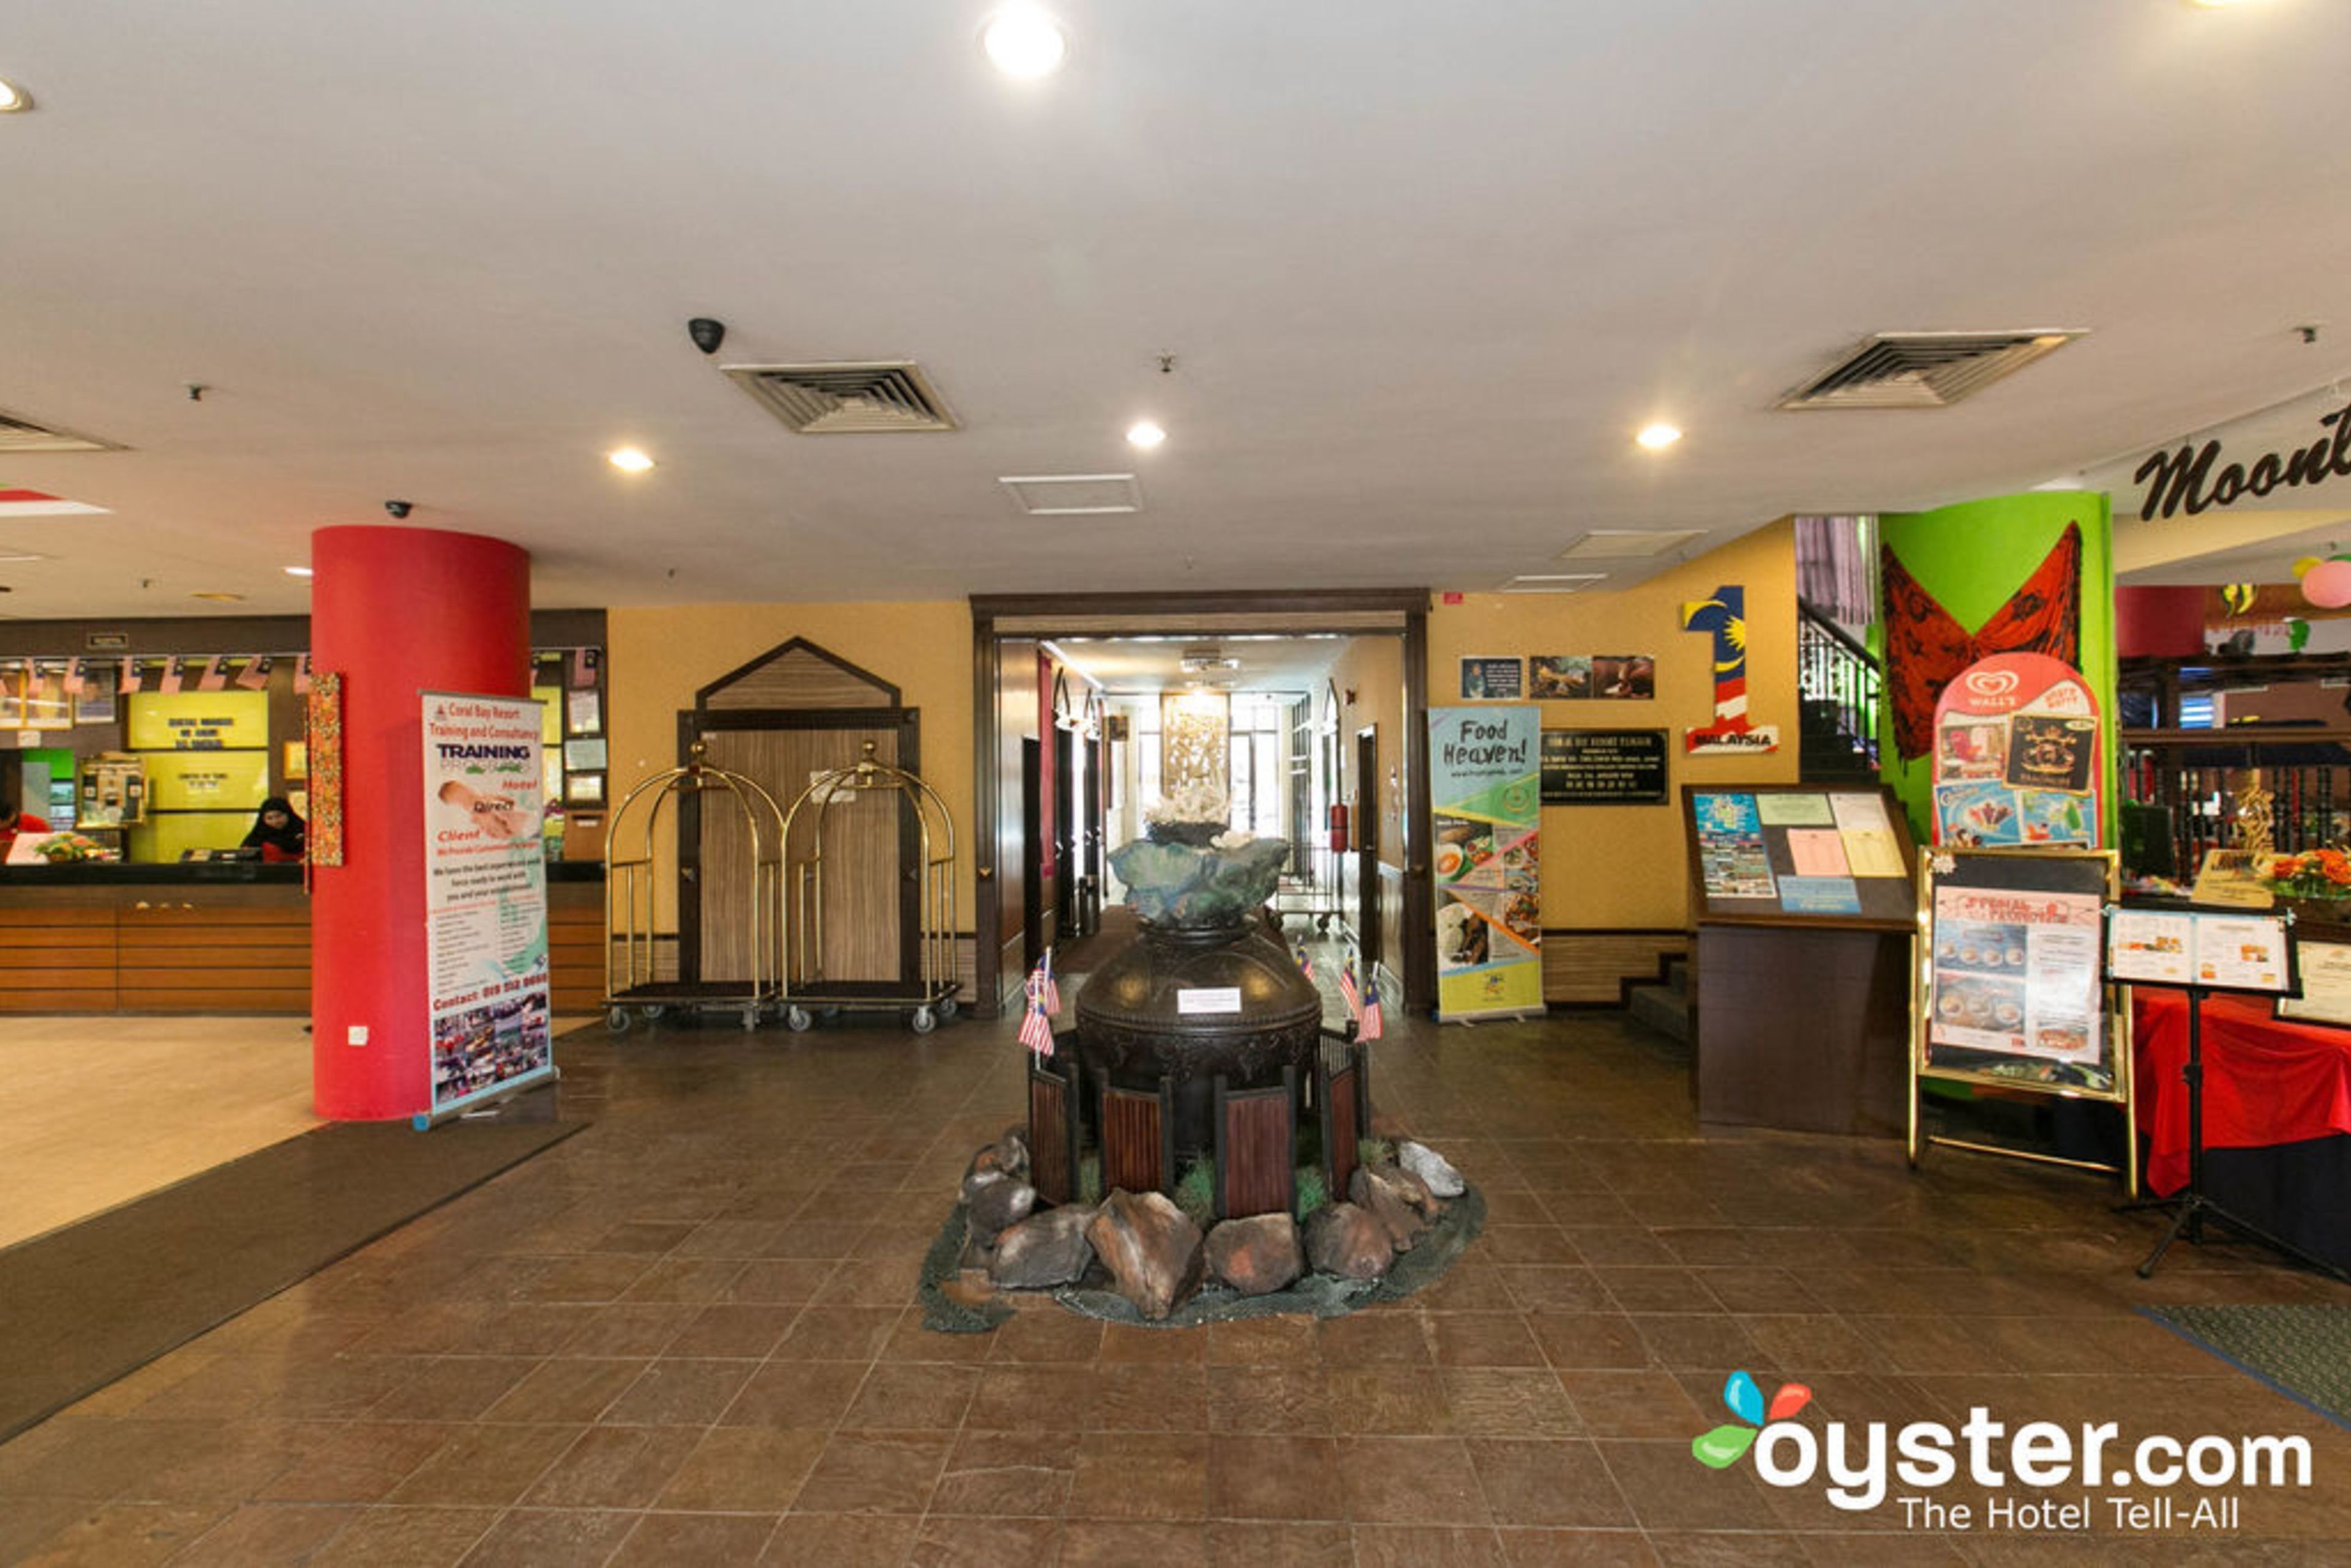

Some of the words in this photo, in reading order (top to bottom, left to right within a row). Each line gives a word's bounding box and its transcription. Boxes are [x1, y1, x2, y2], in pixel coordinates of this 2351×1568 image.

[449, 702, 473, 717] Coral
[475, 705, 489, 721] Bay
[492, 706, 520, 719] Resort
[429, 722, 469, 740] Training
[470, 726, 487, 738] and
[490, 726, 539, 743] Consultancy
[1460, 719, 1507, 743] Food
[1695, 734, 1771, 745] MALAYSIA
[437, 744, 531, 760] TRAINING
[1444, 738, 1527, 765] Heaven!
[438, 829, 481, 842] Client
